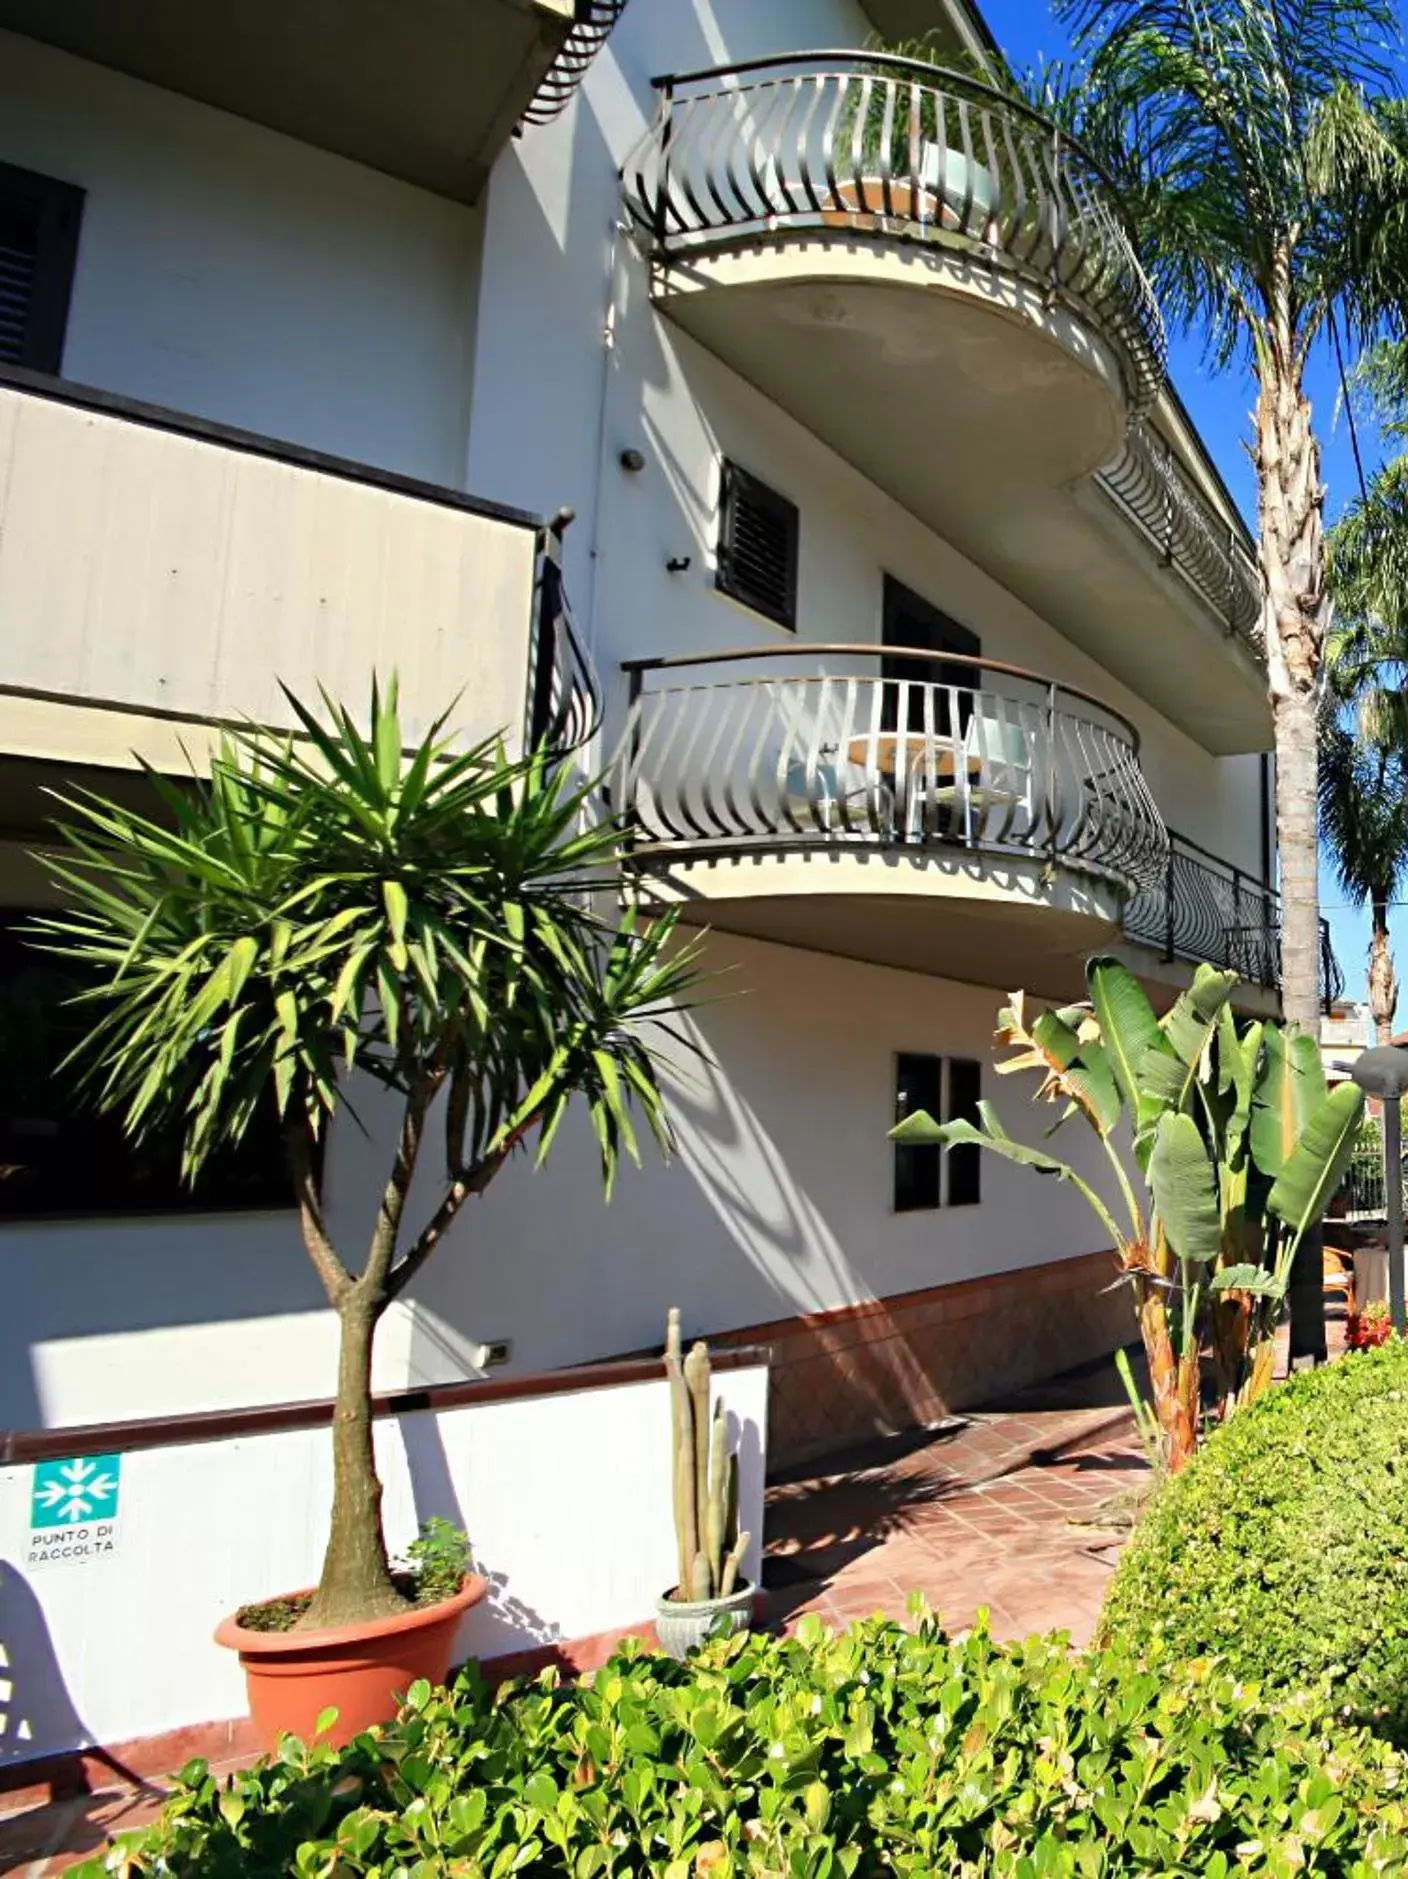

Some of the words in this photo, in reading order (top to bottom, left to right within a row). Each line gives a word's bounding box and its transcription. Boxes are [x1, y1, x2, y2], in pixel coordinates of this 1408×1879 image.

[32, 1529, 89, 1546] PUNTO
[97, 1525, 113, 1537] DI
[28, 1541, 113, 1562] RACCOLTA
